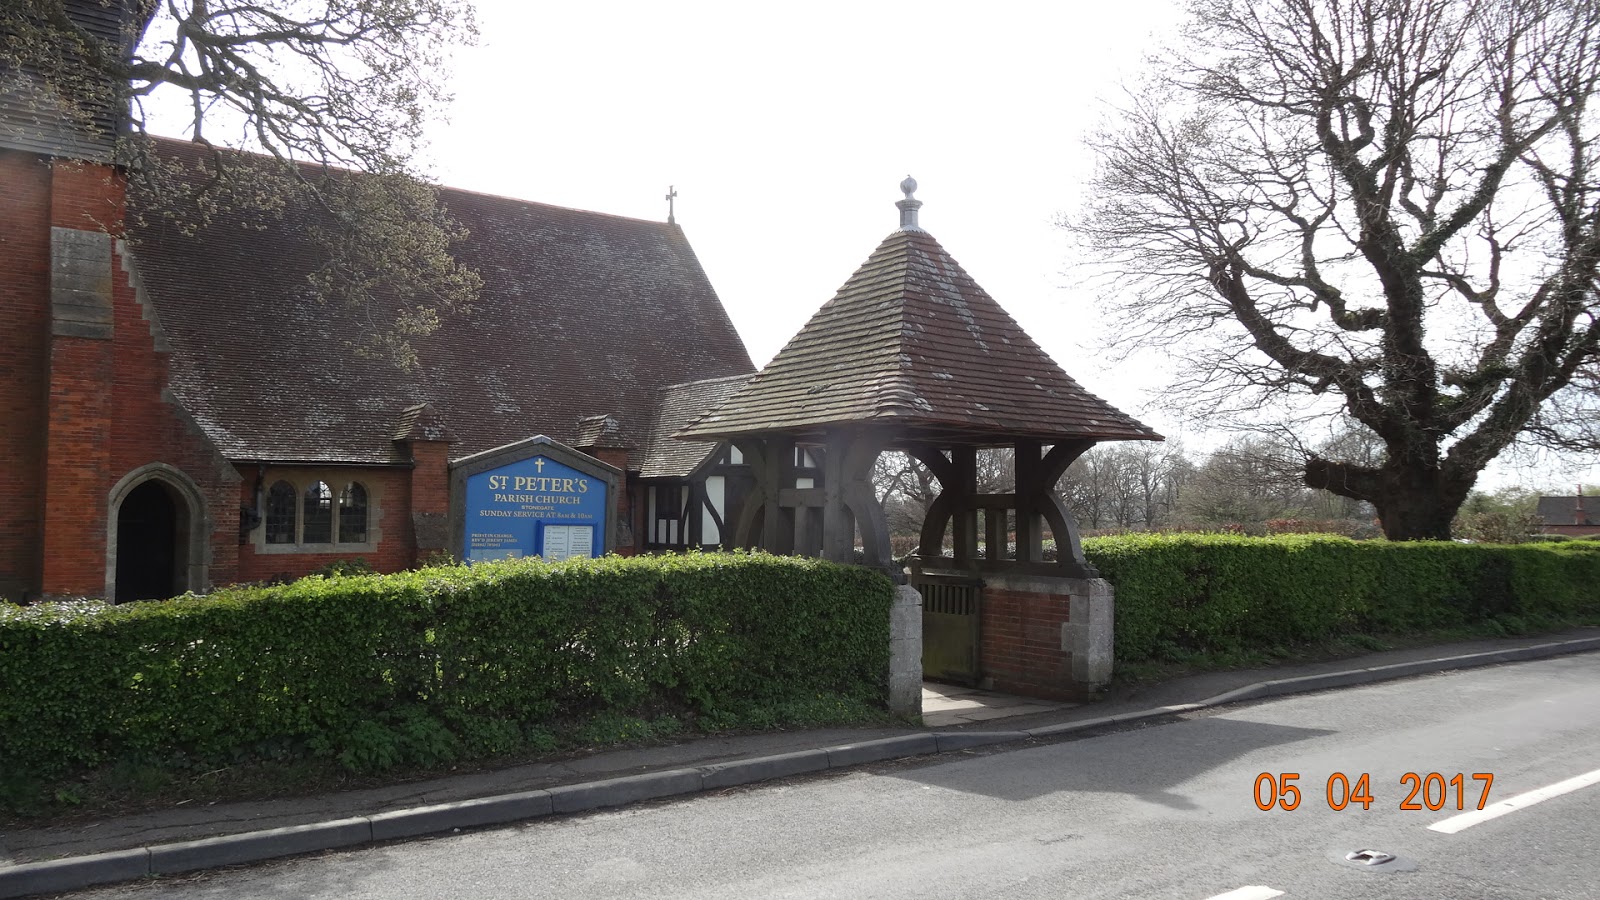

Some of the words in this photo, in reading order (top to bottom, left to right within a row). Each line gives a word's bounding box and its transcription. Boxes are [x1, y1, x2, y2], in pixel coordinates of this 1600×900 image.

[514, 476, 588, 493] PETER'S
[494, 493, 533, 503] PARISH
[535, 495, 580, 504] CHURCH
